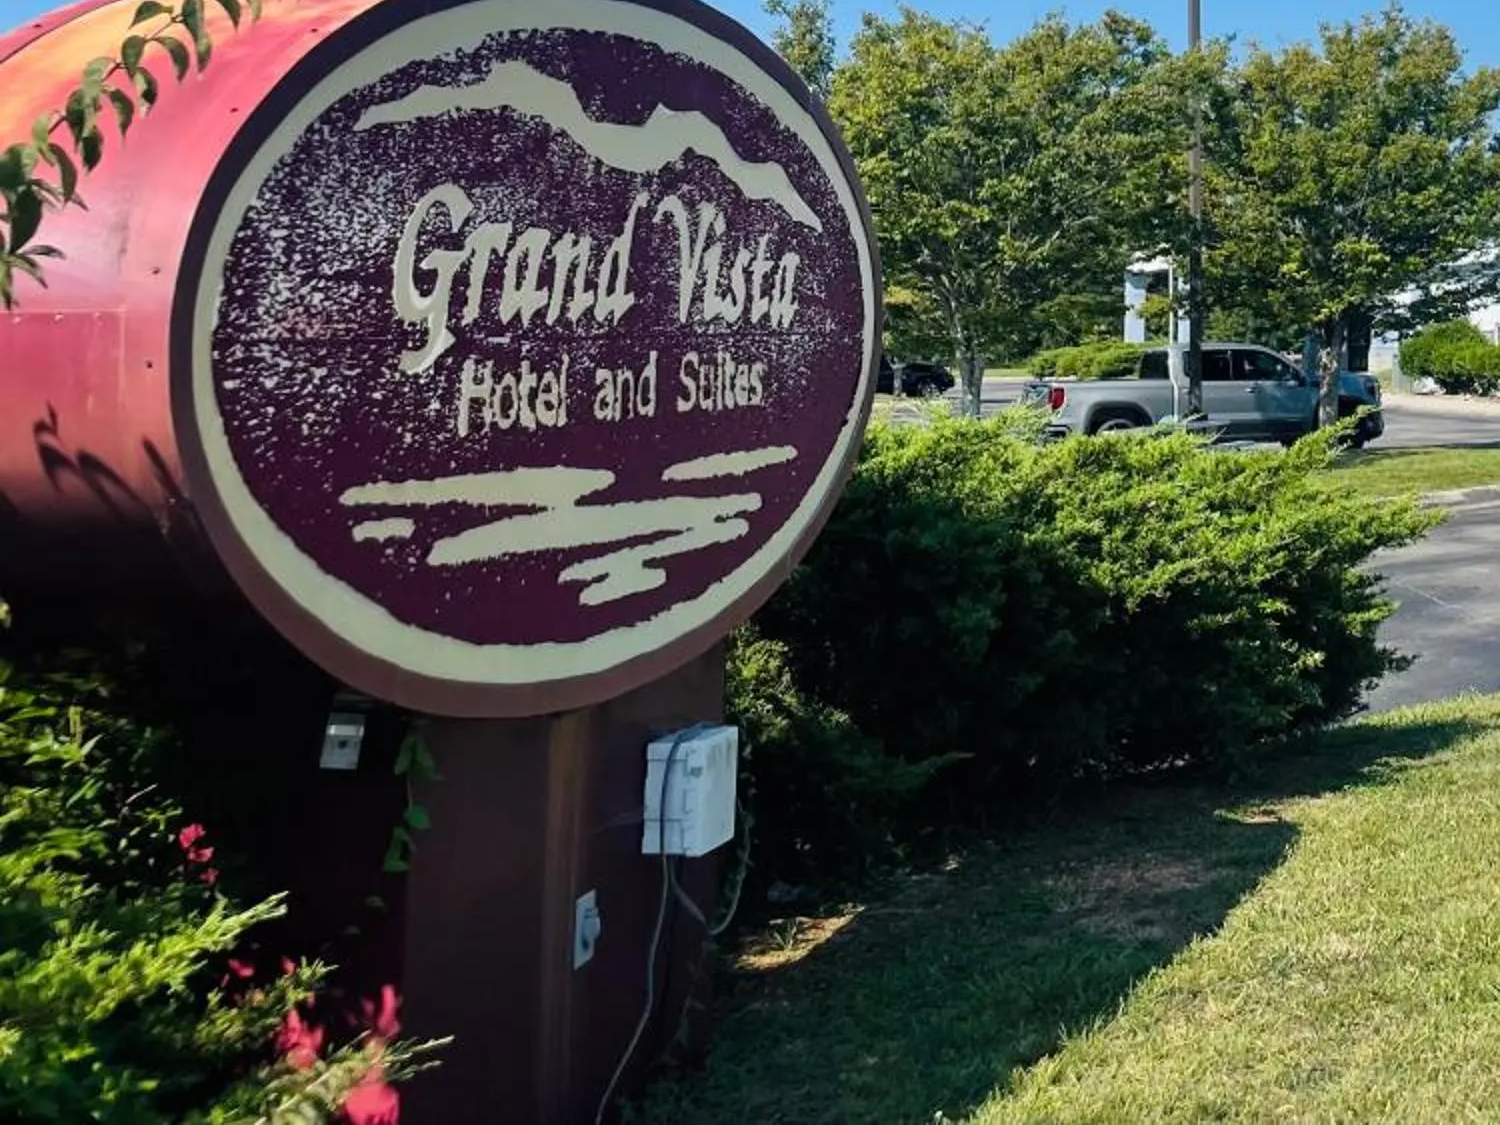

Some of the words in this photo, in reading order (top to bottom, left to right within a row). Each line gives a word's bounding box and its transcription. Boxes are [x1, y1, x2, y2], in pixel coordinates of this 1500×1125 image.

[392, 183, 649, 374] Grand
[653, 195, 800, 327] Vista
[457, 353, 567, 437] Hotel
[593, 350, 658, 421] and
[677, 351, 767, 412] Suites
